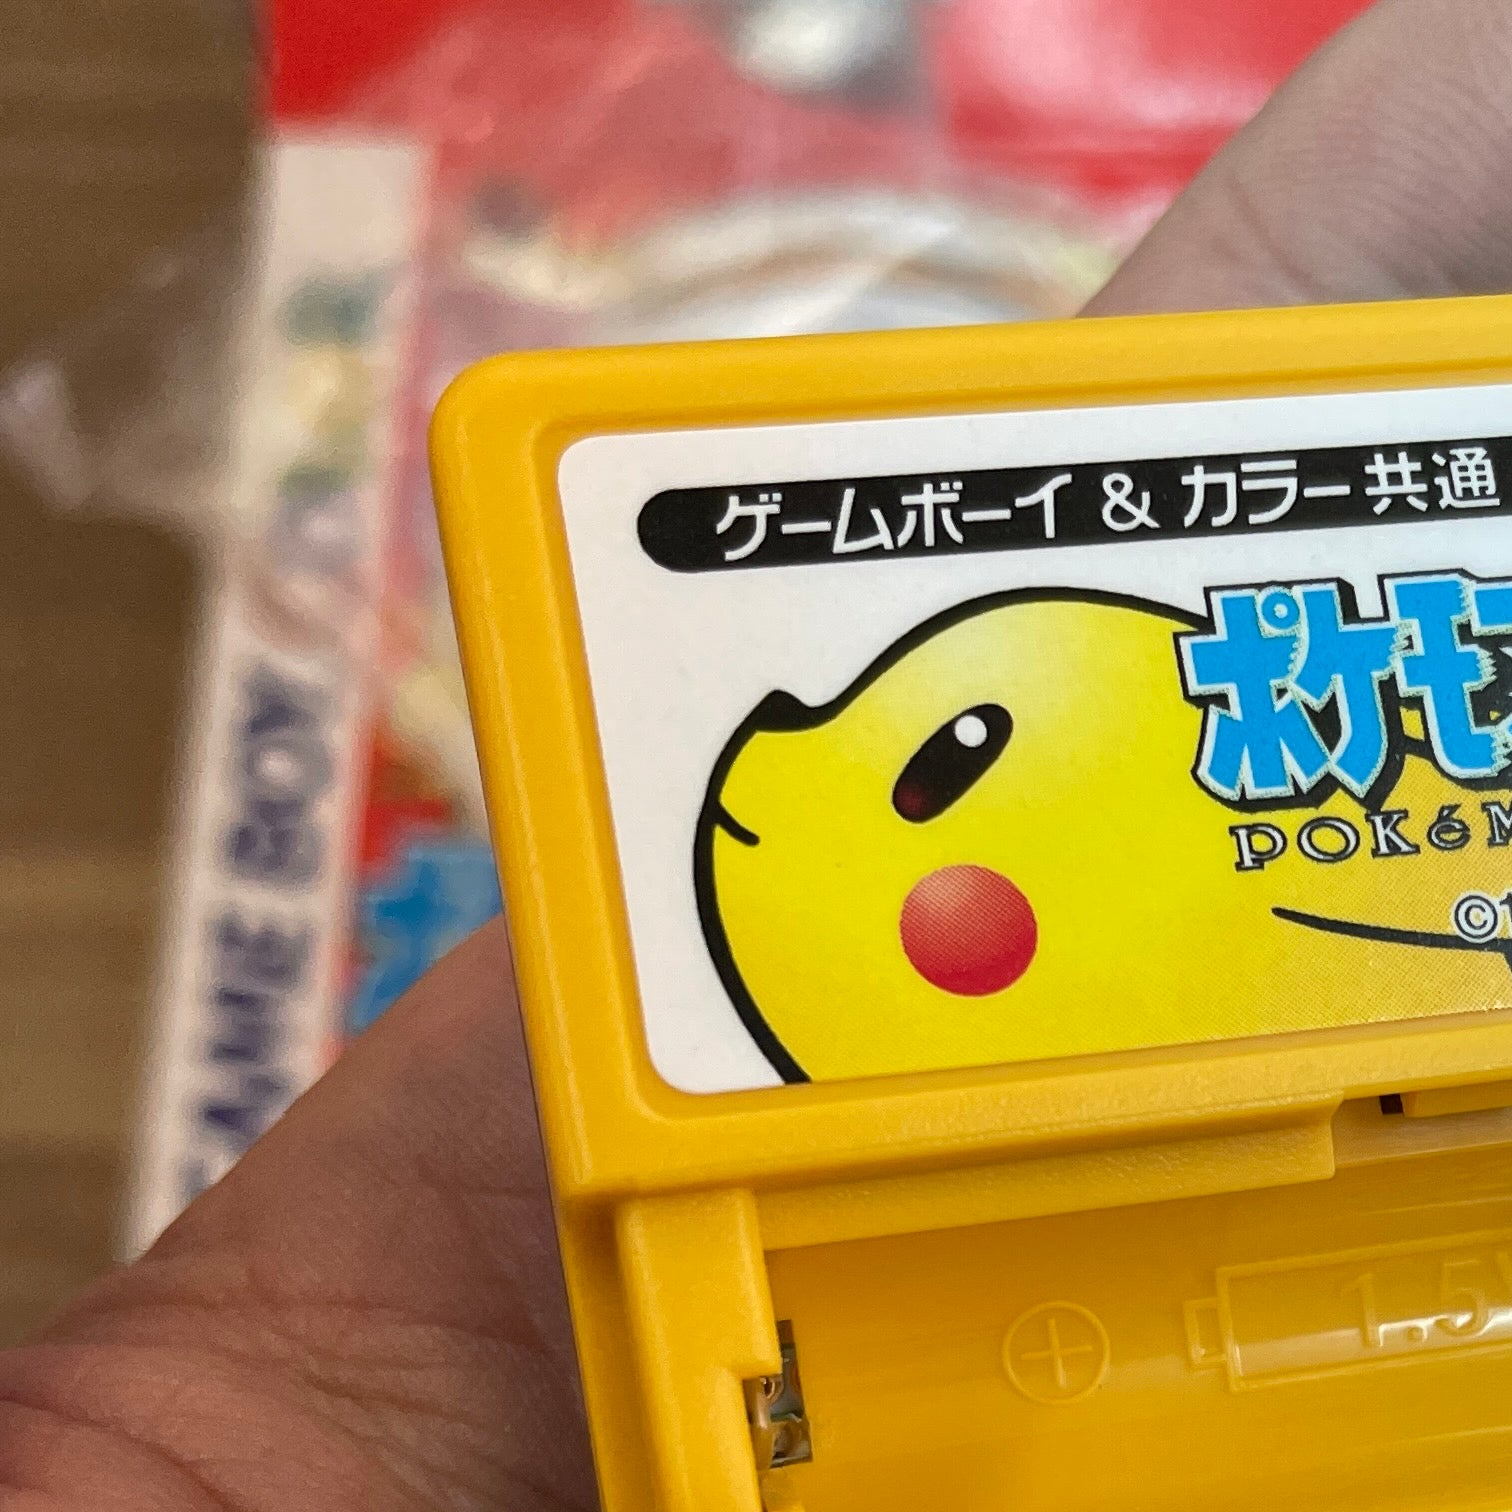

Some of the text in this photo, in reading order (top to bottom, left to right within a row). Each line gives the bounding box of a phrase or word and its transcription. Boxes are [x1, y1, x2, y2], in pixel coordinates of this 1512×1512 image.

[715, 447, 1502, 563] ゲームボーイ & カラー共通
